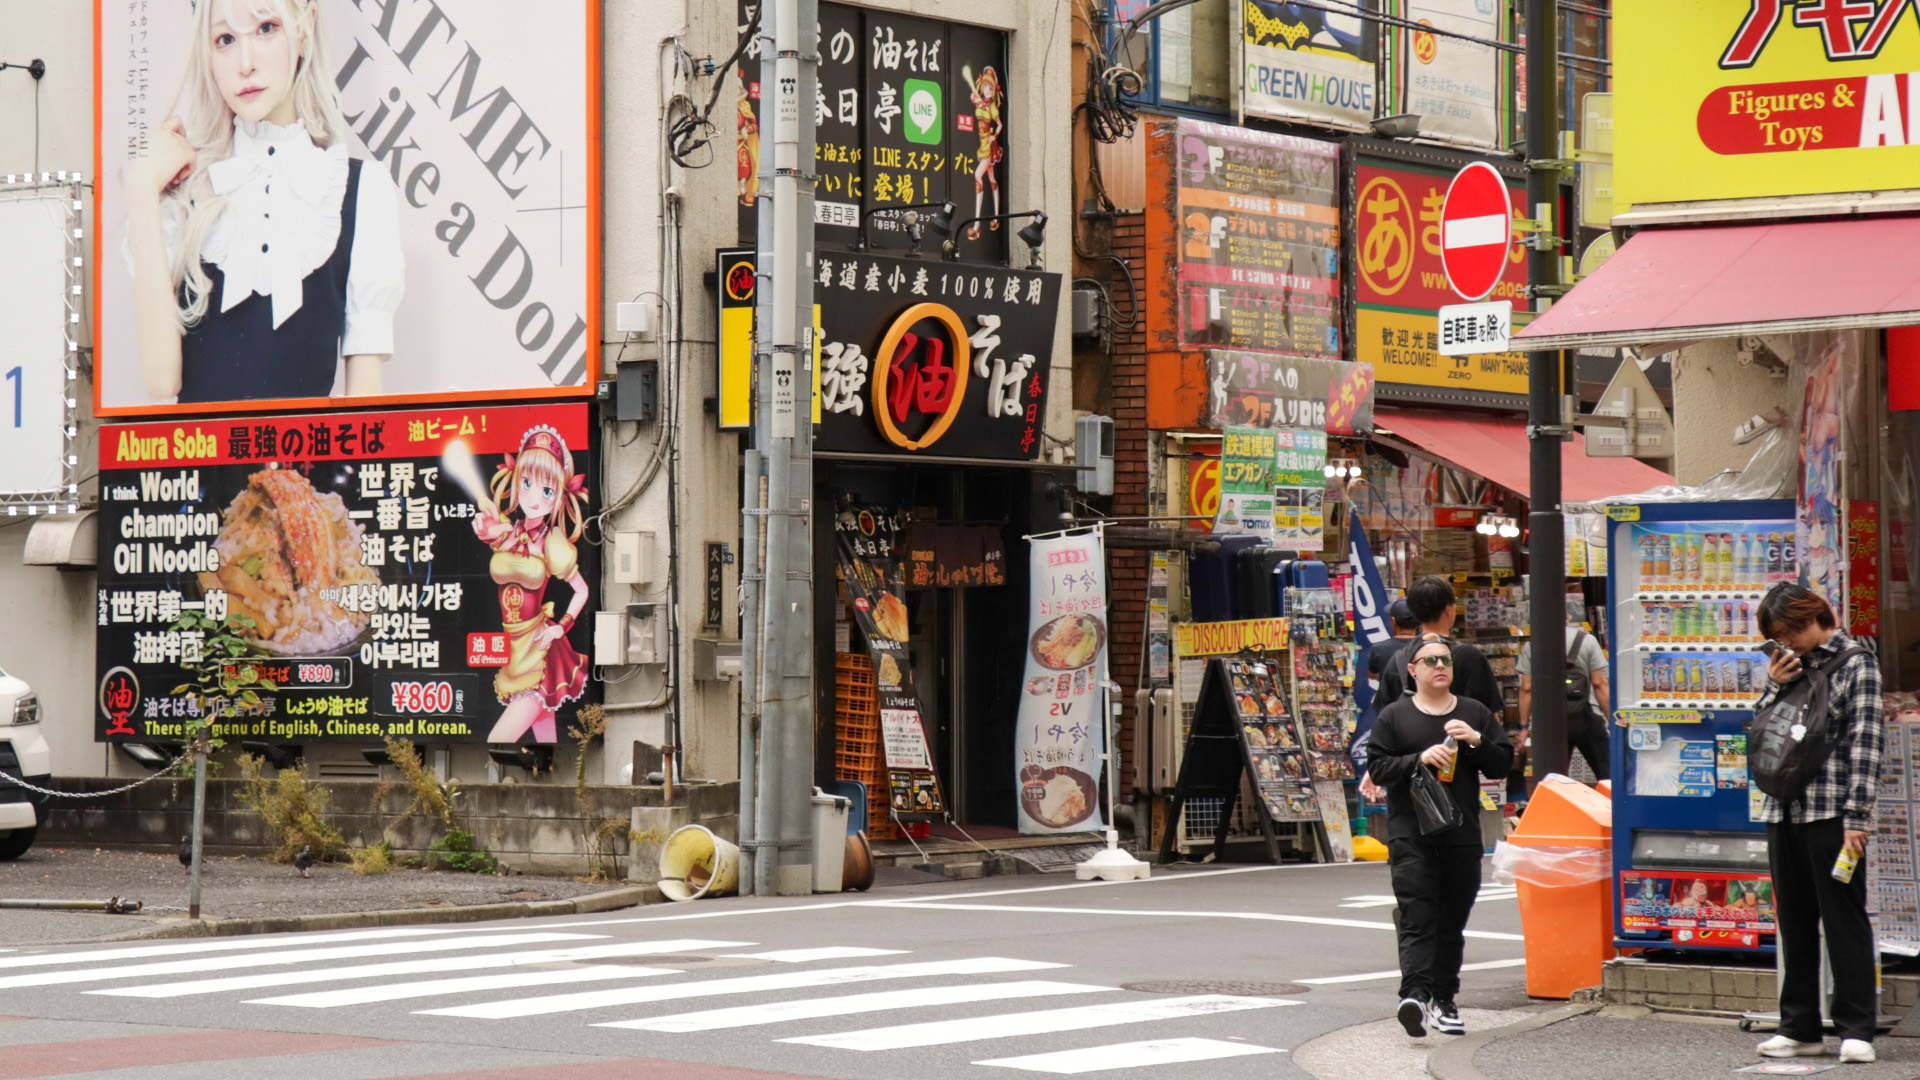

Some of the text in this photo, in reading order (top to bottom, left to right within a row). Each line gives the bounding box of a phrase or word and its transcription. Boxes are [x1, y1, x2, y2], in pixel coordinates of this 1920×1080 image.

[1248, 63, 1372, 111] GREEN HOUSE
[1728, 90, 1826, 120] Figures
[1832, 83, 1856, 108] &
[427, 40, 552, 200] ME
[914, 102, 933, 117] LINE
[334, 37, 441, 209] Like
[435, 201, 477, 257] a
[1759, 121, 1824, 150] Toys
[874, 147, 900, 168] LINE
[815, 258, 1043, 305] 海道産小麦100%使用
[1443, 314, 1506, 346] 自転車を除く
[1383, 348, 1438, 368] WELCOME!!
[1480, 360, 1501, 374] MANY
[1448, 370, 1472, 381] ZERO
[6, 366, 22, 428] 1
[1020, 371, 1043, 453] 春日亭
[116, 427, 217, 462] Abura Soba
[228, 421, 385, 460] 最強の油そば
[1226, 433, 1275, 458] 鉄道模型
[113, 486, 138, 501] think
[140, 470, 200, 502] World
[358, 463, 439, 498] 世界で
[1224, 462, 1263, 484] エアガン
[121, 505, 219, 545] champion
[348, 496, 476, 531] 一番旨いと思う
[1242, 518, 1271, 530] TOMIX
[114, 540, 220, 575] Oil Noodle
[359, 533, 437, 567] 油そば
[110, 588, 228, 623] 世界第一的
[319, 583, 462, 612] 아마 세상에서 가장
[370, 612, 431, 640] 맛있는
[1193, 621, 1249, 653] DISCOUNT
[1253, 618, 1288, 650] STORE
[360, 641, 439, 668] 아부라면
[299, 664, 333, 682] ¥890
[286, 695, 368, 717] しょうゆ油そば
[391, 681, 453, 714] ¥860
[145, 719, 182, 735] There
[212, 723, 248, 735] menu
[252, 719, 266, 735] of
[270, 719, 322, 738] English,
[327, 719, 384, 737] Chinese,
[388, 719, 415, 735] and
[418, 719, 472, 735] Korean.
